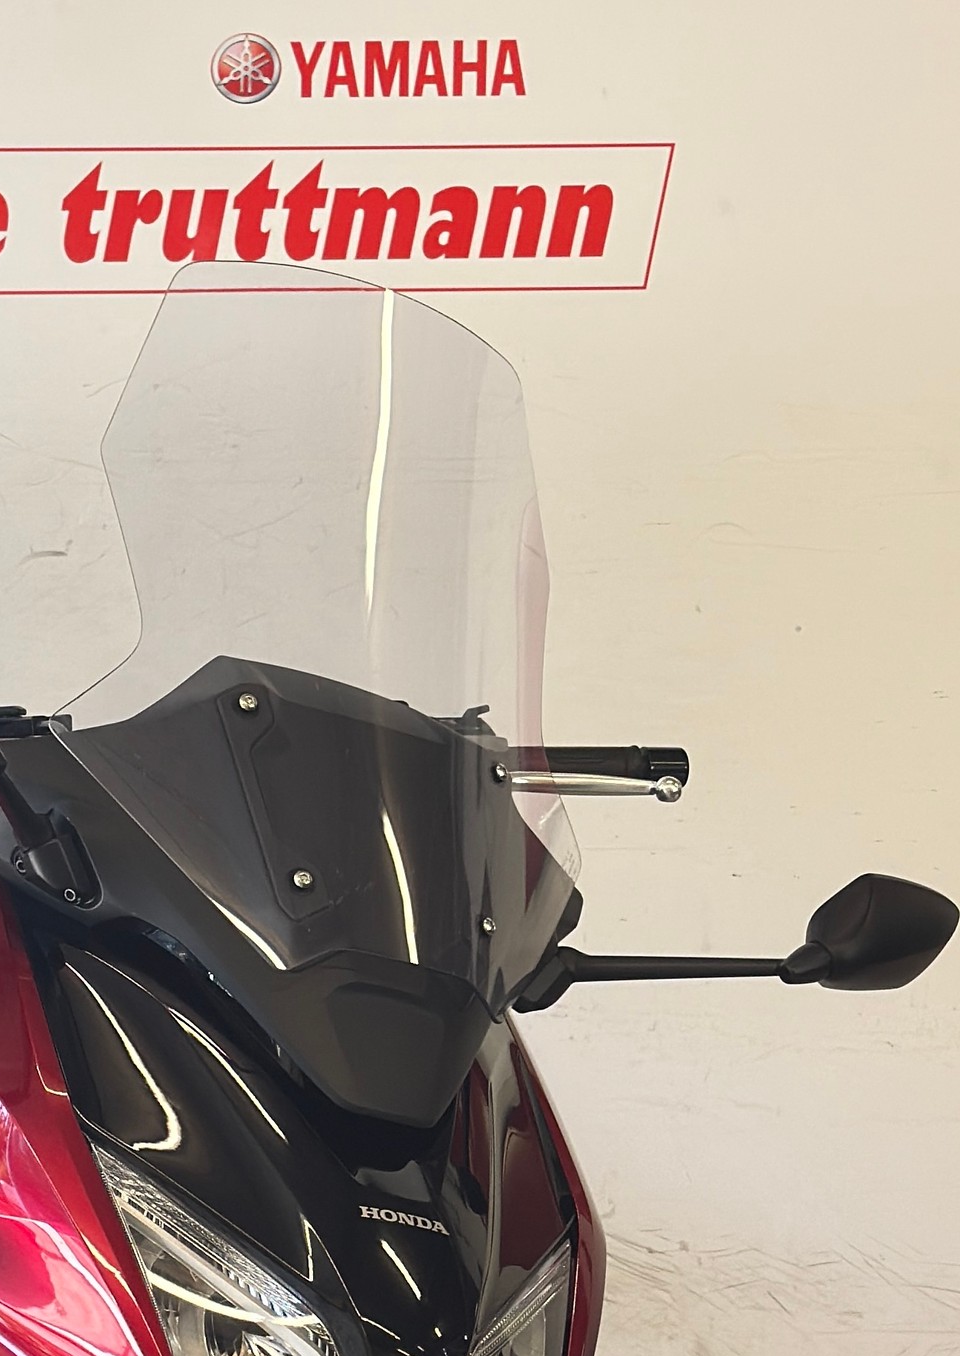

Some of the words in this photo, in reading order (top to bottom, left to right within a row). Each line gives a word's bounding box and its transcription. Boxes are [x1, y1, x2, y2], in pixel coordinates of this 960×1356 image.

[290, 39, 527, 98] YAMAHA
[61, 160, 614, 264] truttmann
[359, 1205, 450, 1236] HONDA
